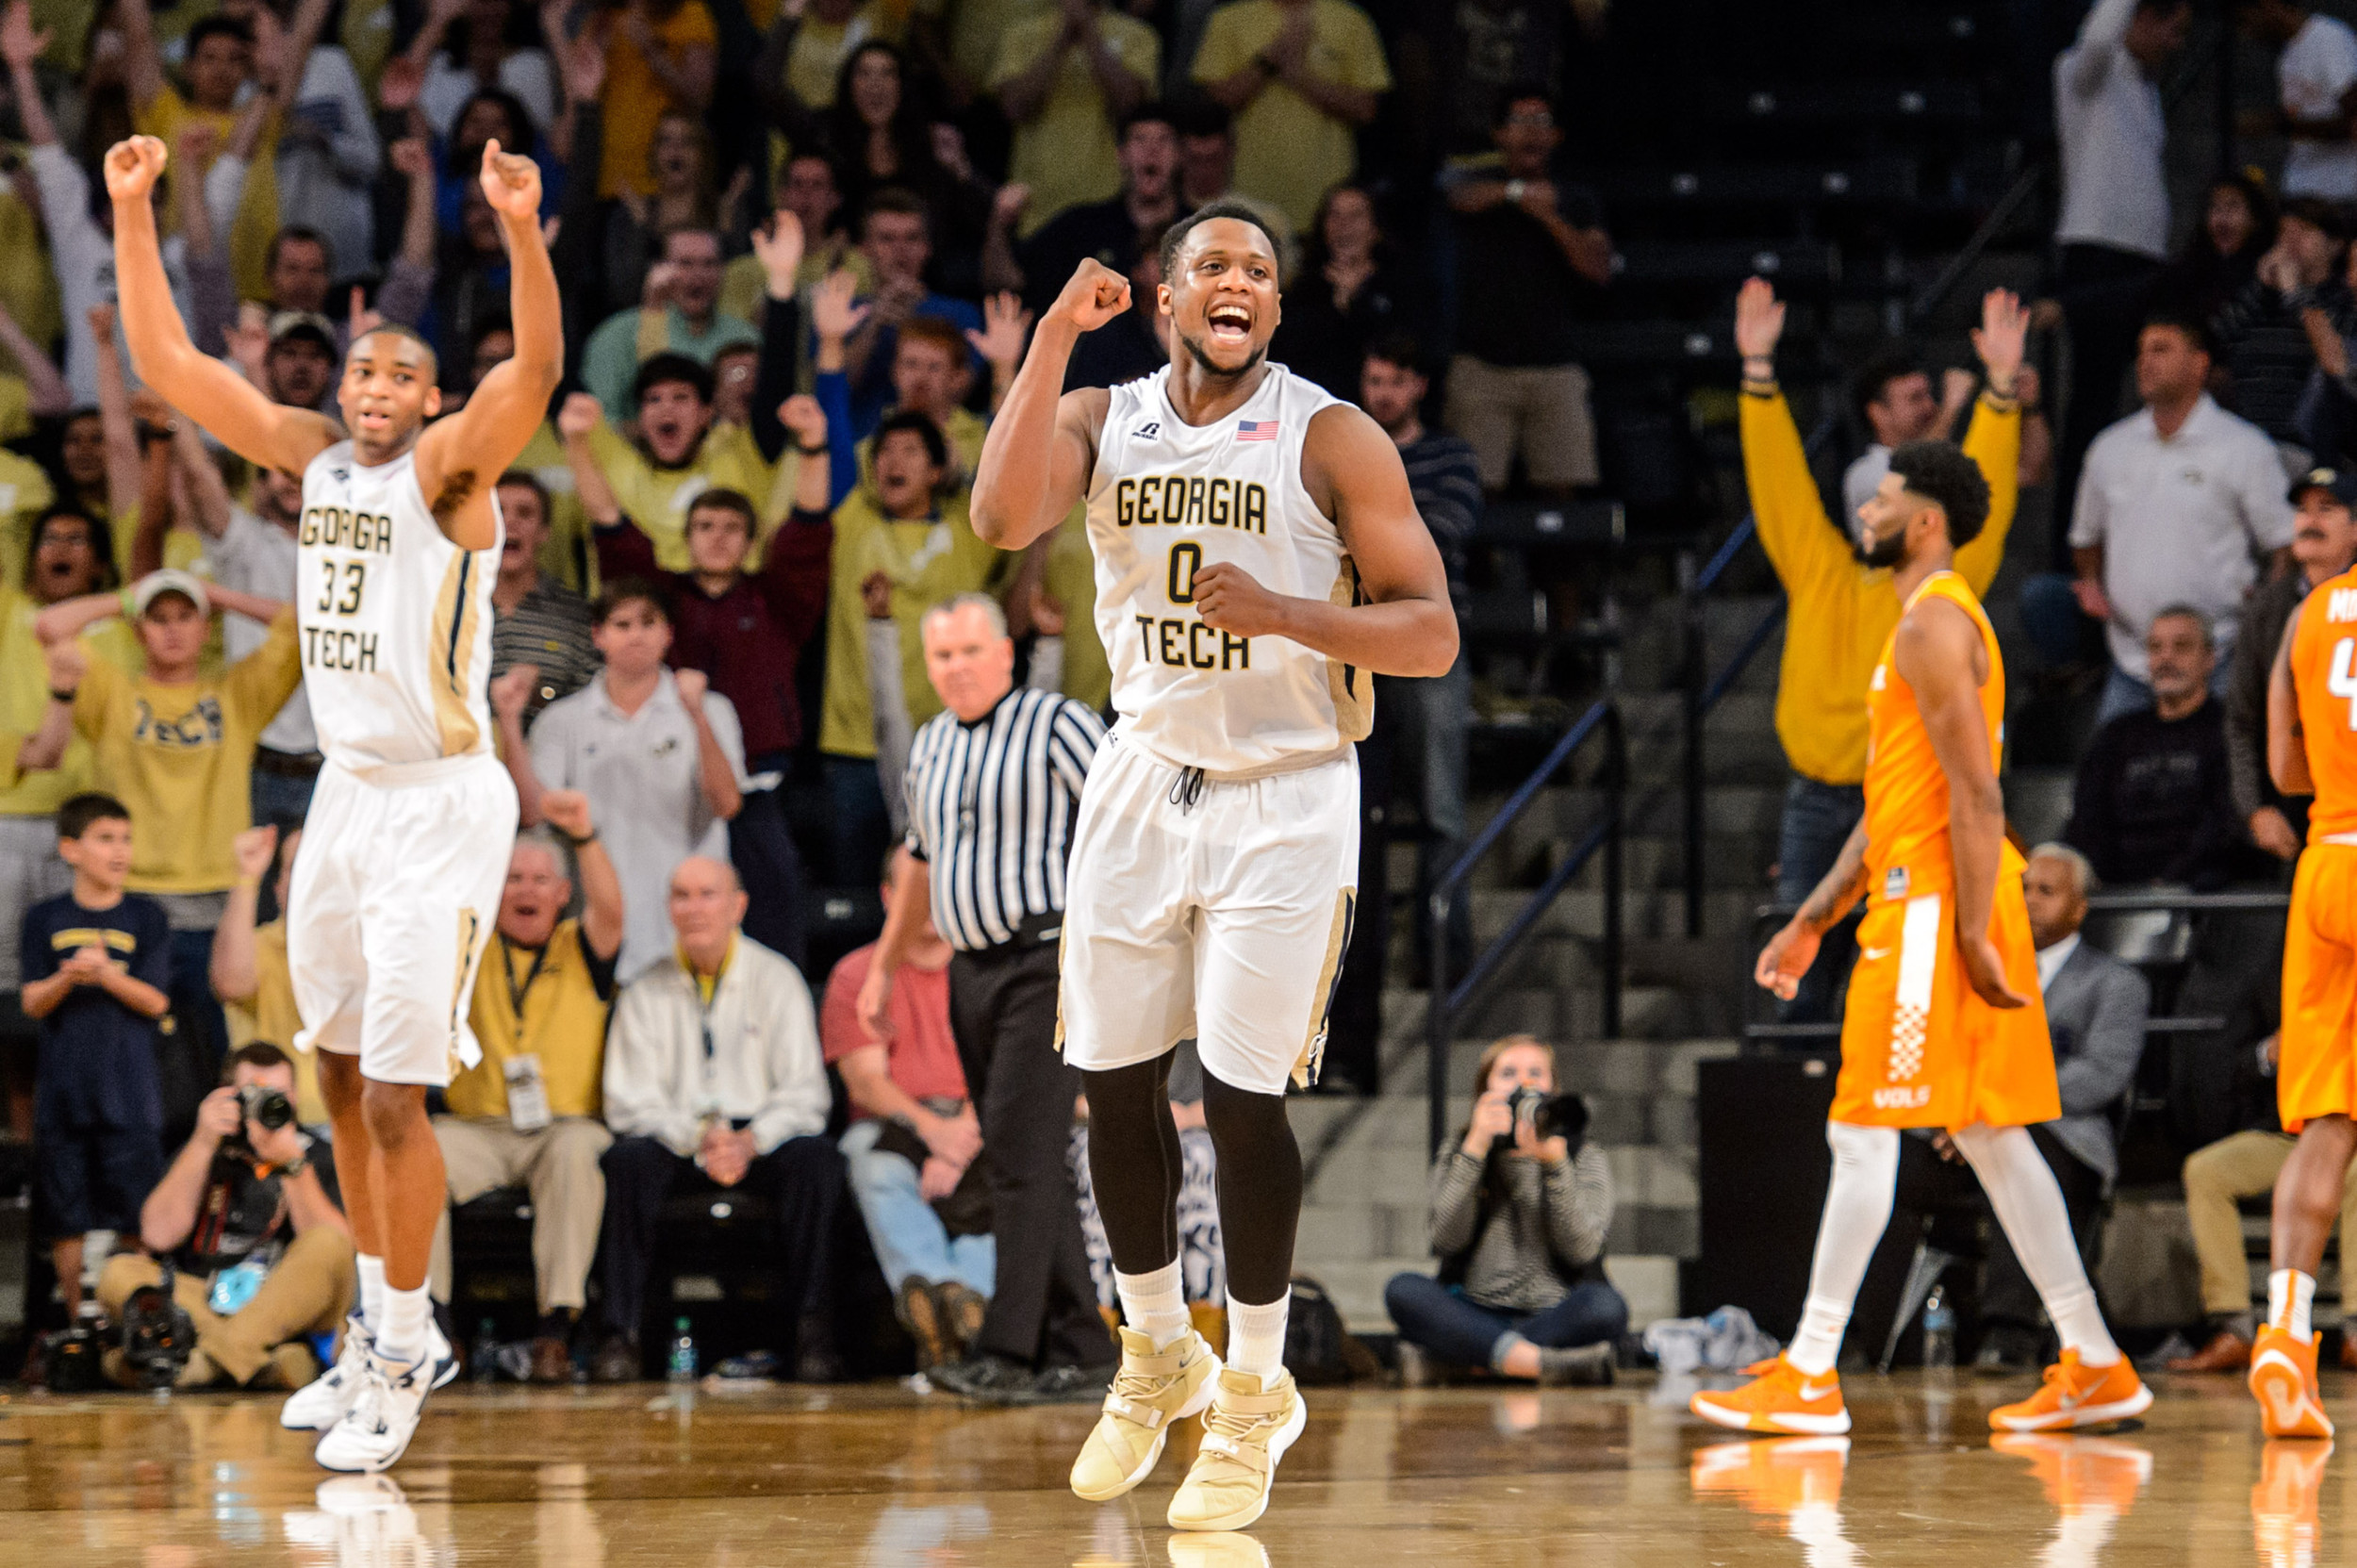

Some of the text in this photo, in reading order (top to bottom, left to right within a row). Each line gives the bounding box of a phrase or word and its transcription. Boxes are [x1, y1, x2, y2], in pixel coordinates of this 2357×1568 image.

[301, 507, 392, 554] GORGA
[1116, 475, 1266, 536] GEORGIA
[318, 557, 366, 617] 33
[1166, 538, 1204, 606] 0
[305, 627, 378, 672] TECH
[1135, 613, 1251, 671] TECH
[1872, 1084, 1932, 1110] VOLS
